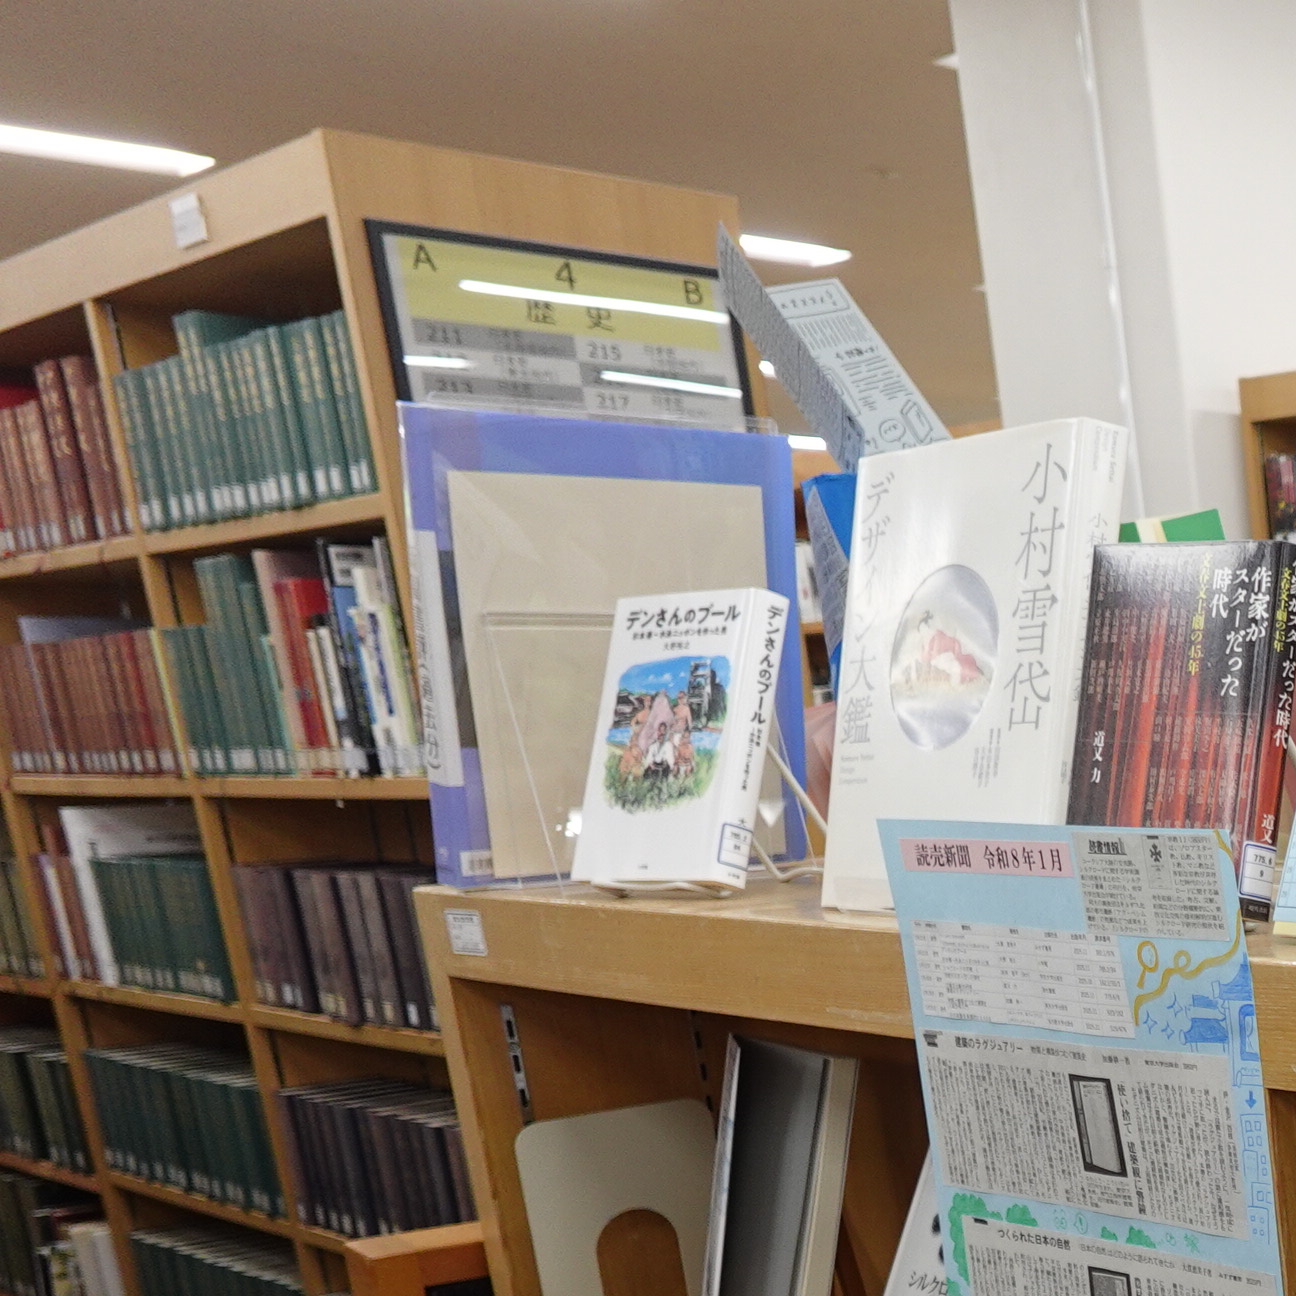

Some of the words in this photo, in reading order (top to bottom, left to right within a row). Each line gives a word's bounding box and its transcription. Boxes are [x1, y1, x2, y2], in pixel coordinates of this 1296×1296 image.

[413, 243, 437, 272] A
[555, 260, 577, 290] 4
[684, 279, 703, 305] B
[840, 470, 896, 746] デザイン大鑑
[1211, 568, 1233, 619] 時代
[1248, 566, 1273, 643] 作家が
[1219, 567, 1250, 698] スターだった
[915, 844, 972, 869] 読売新聞
[983, 846, 1063, 873] 令和8年1月
[997, 1228, 1072, 1252] つくられた日本の自然
